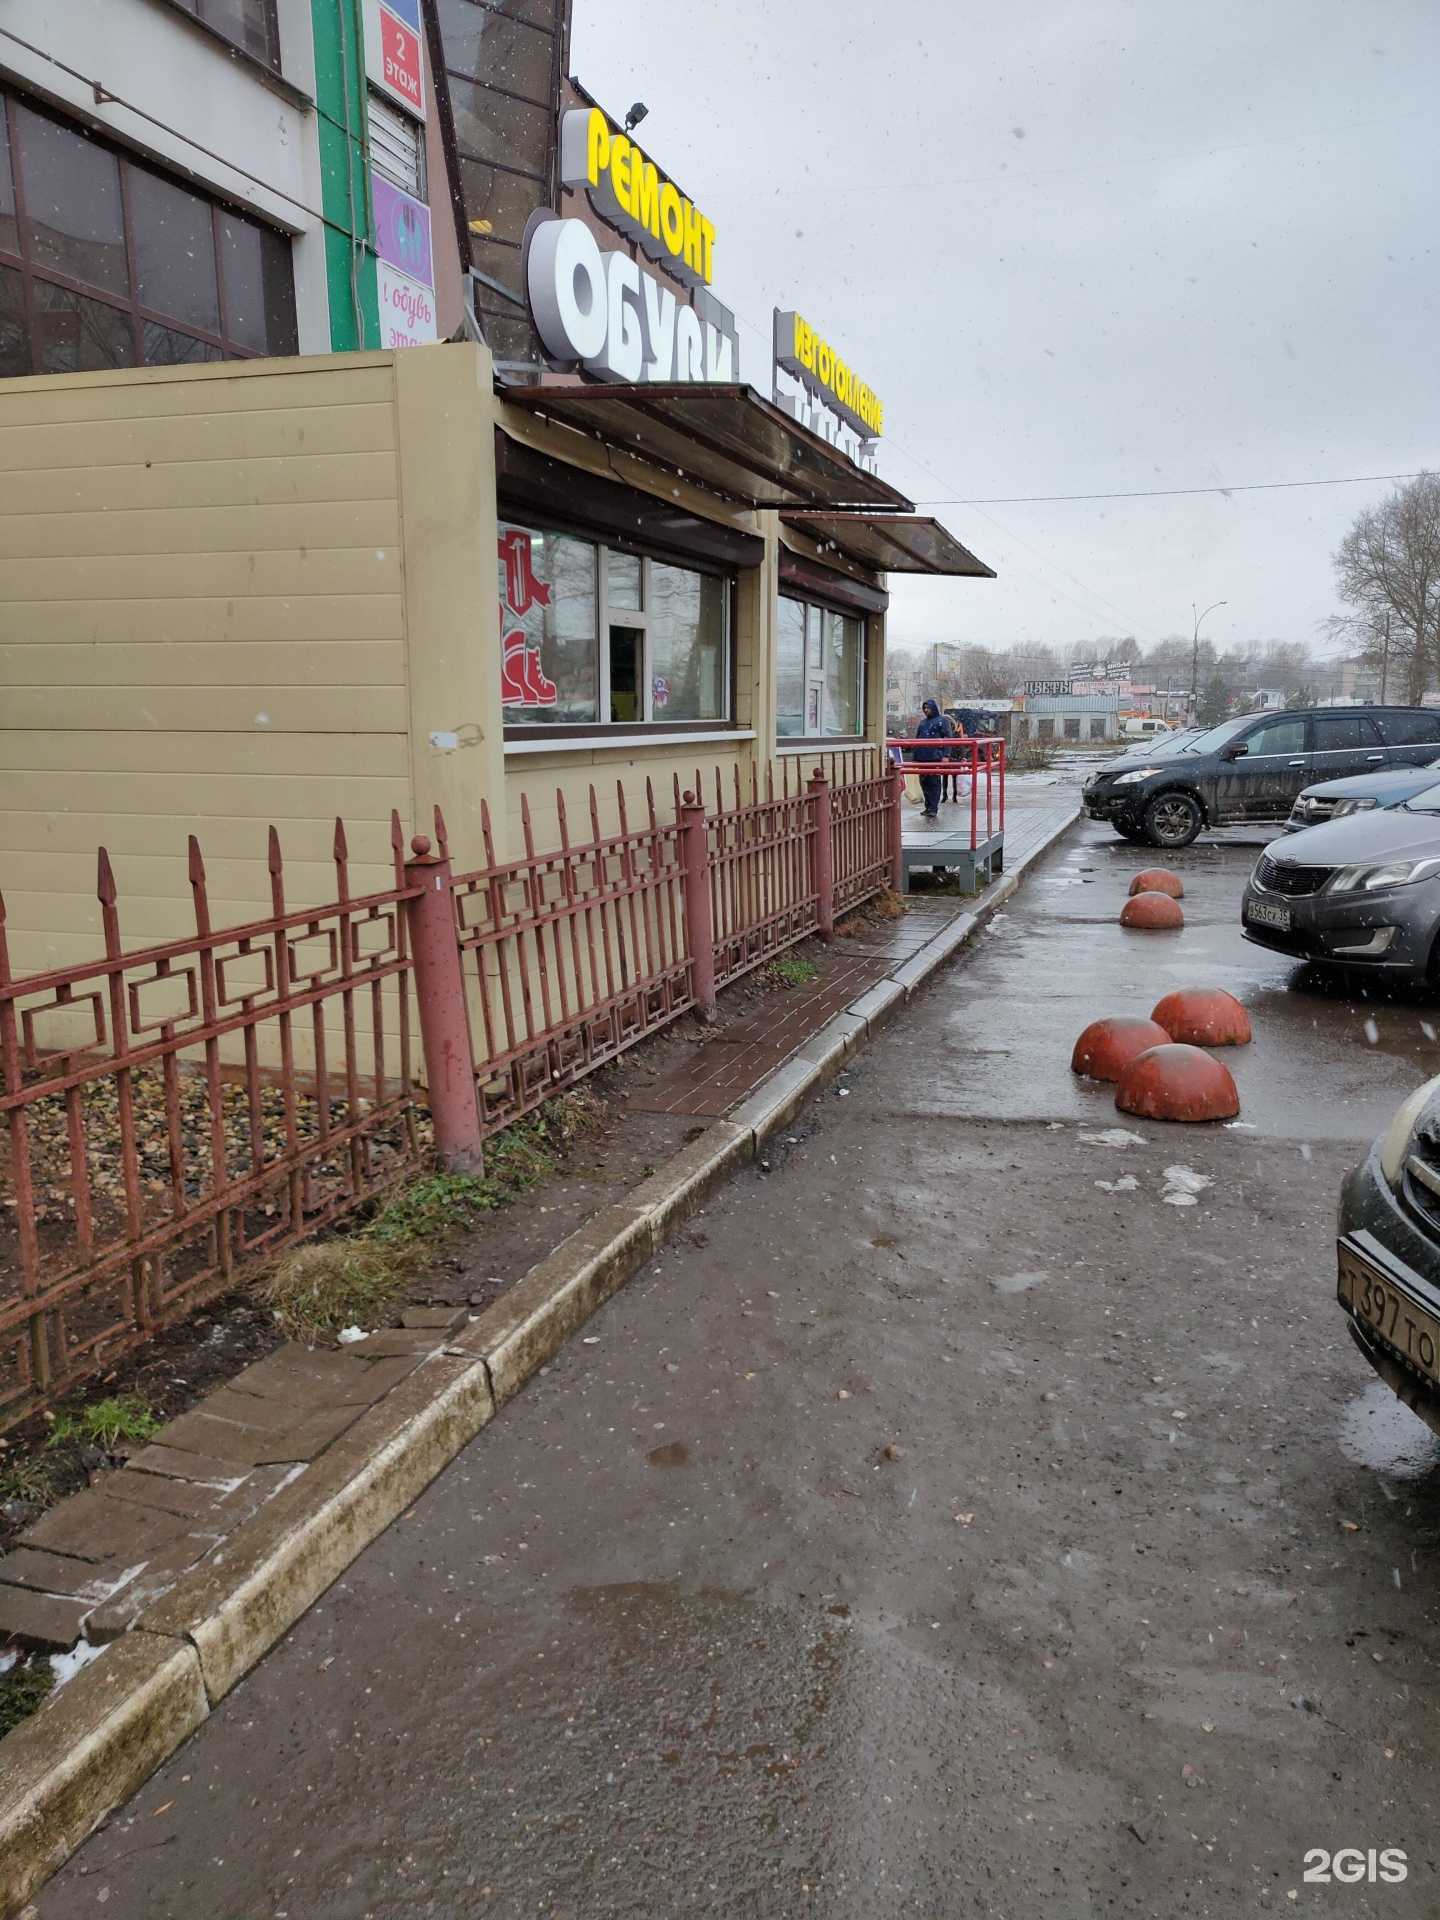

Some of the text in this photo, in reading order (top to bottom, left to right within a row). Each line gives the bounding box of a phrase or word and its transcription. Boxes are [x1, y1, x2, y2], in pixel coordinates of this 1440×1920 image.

[396, 32, 405, 61] 2
[386, 56, 418, 97] этаж
[587, 107, 716, 286] РЕМОНТ
[393, 286, 431, 328] обувь
